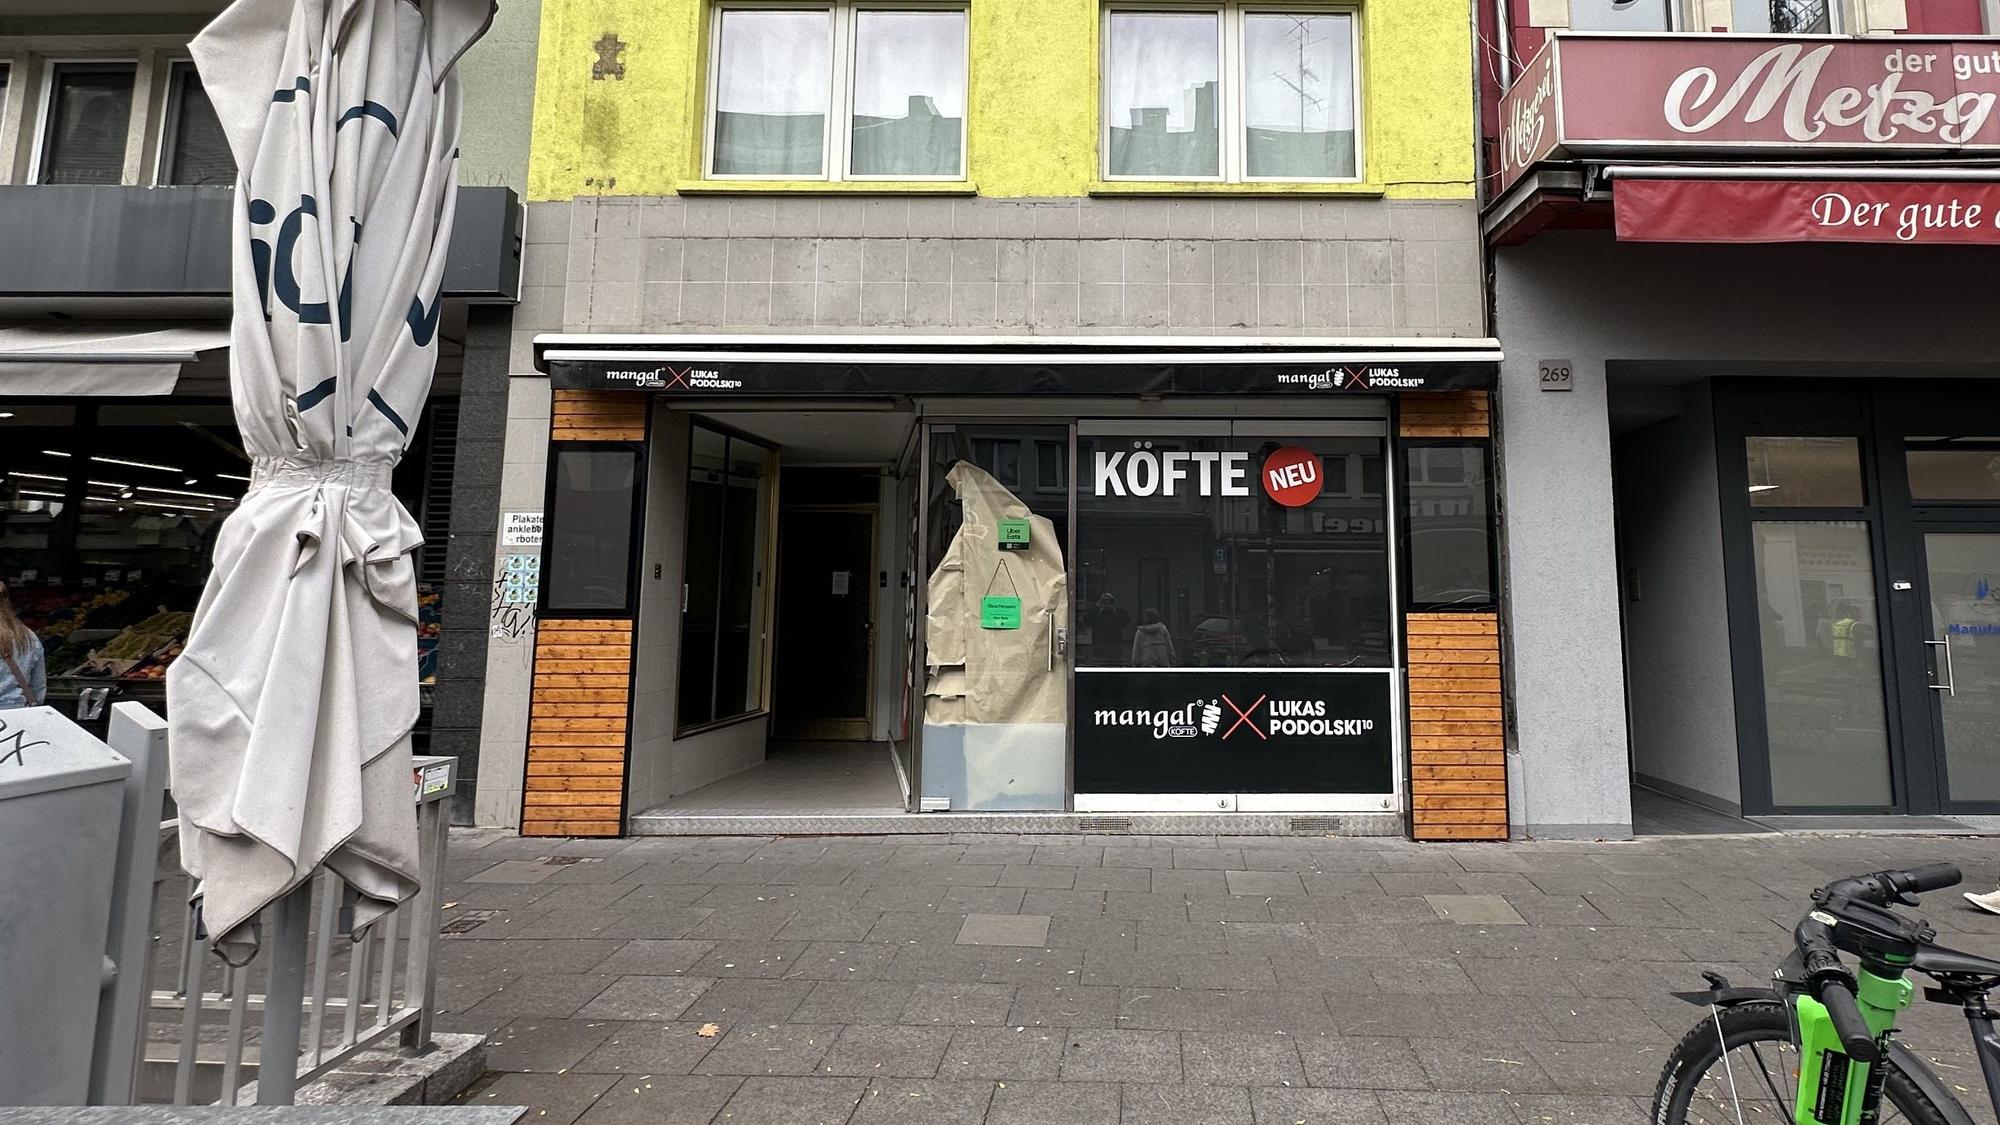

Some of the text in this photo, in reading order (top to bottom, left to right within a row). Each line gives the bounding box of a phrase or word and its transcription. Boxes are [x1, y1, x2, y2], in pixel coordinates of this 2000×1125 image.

[1884, 49, 1937, 73] der
[1663, 43, 1997, 143] Metzg
[1811, 193, 1890, 227] Der
[1896, 199, 1982, 240] gute
[606, 368, 661, 387] mangal
[690, 370, 719, 379] LUKAS
[1277, 369, 1332, 390] mangal
[1368, 368, 1400, 378] LUKAS
[1540, 367, 1569, 381] 269
[1095, 440, 1250, 497] KÖFTE
[1269, 461, 1317, 492] NEU
[1269, 700, 1326, 717] LUKAS
[1093, 702, 1196, 739] mangal
[1169, 726, 1197, 737] KÖFTE
